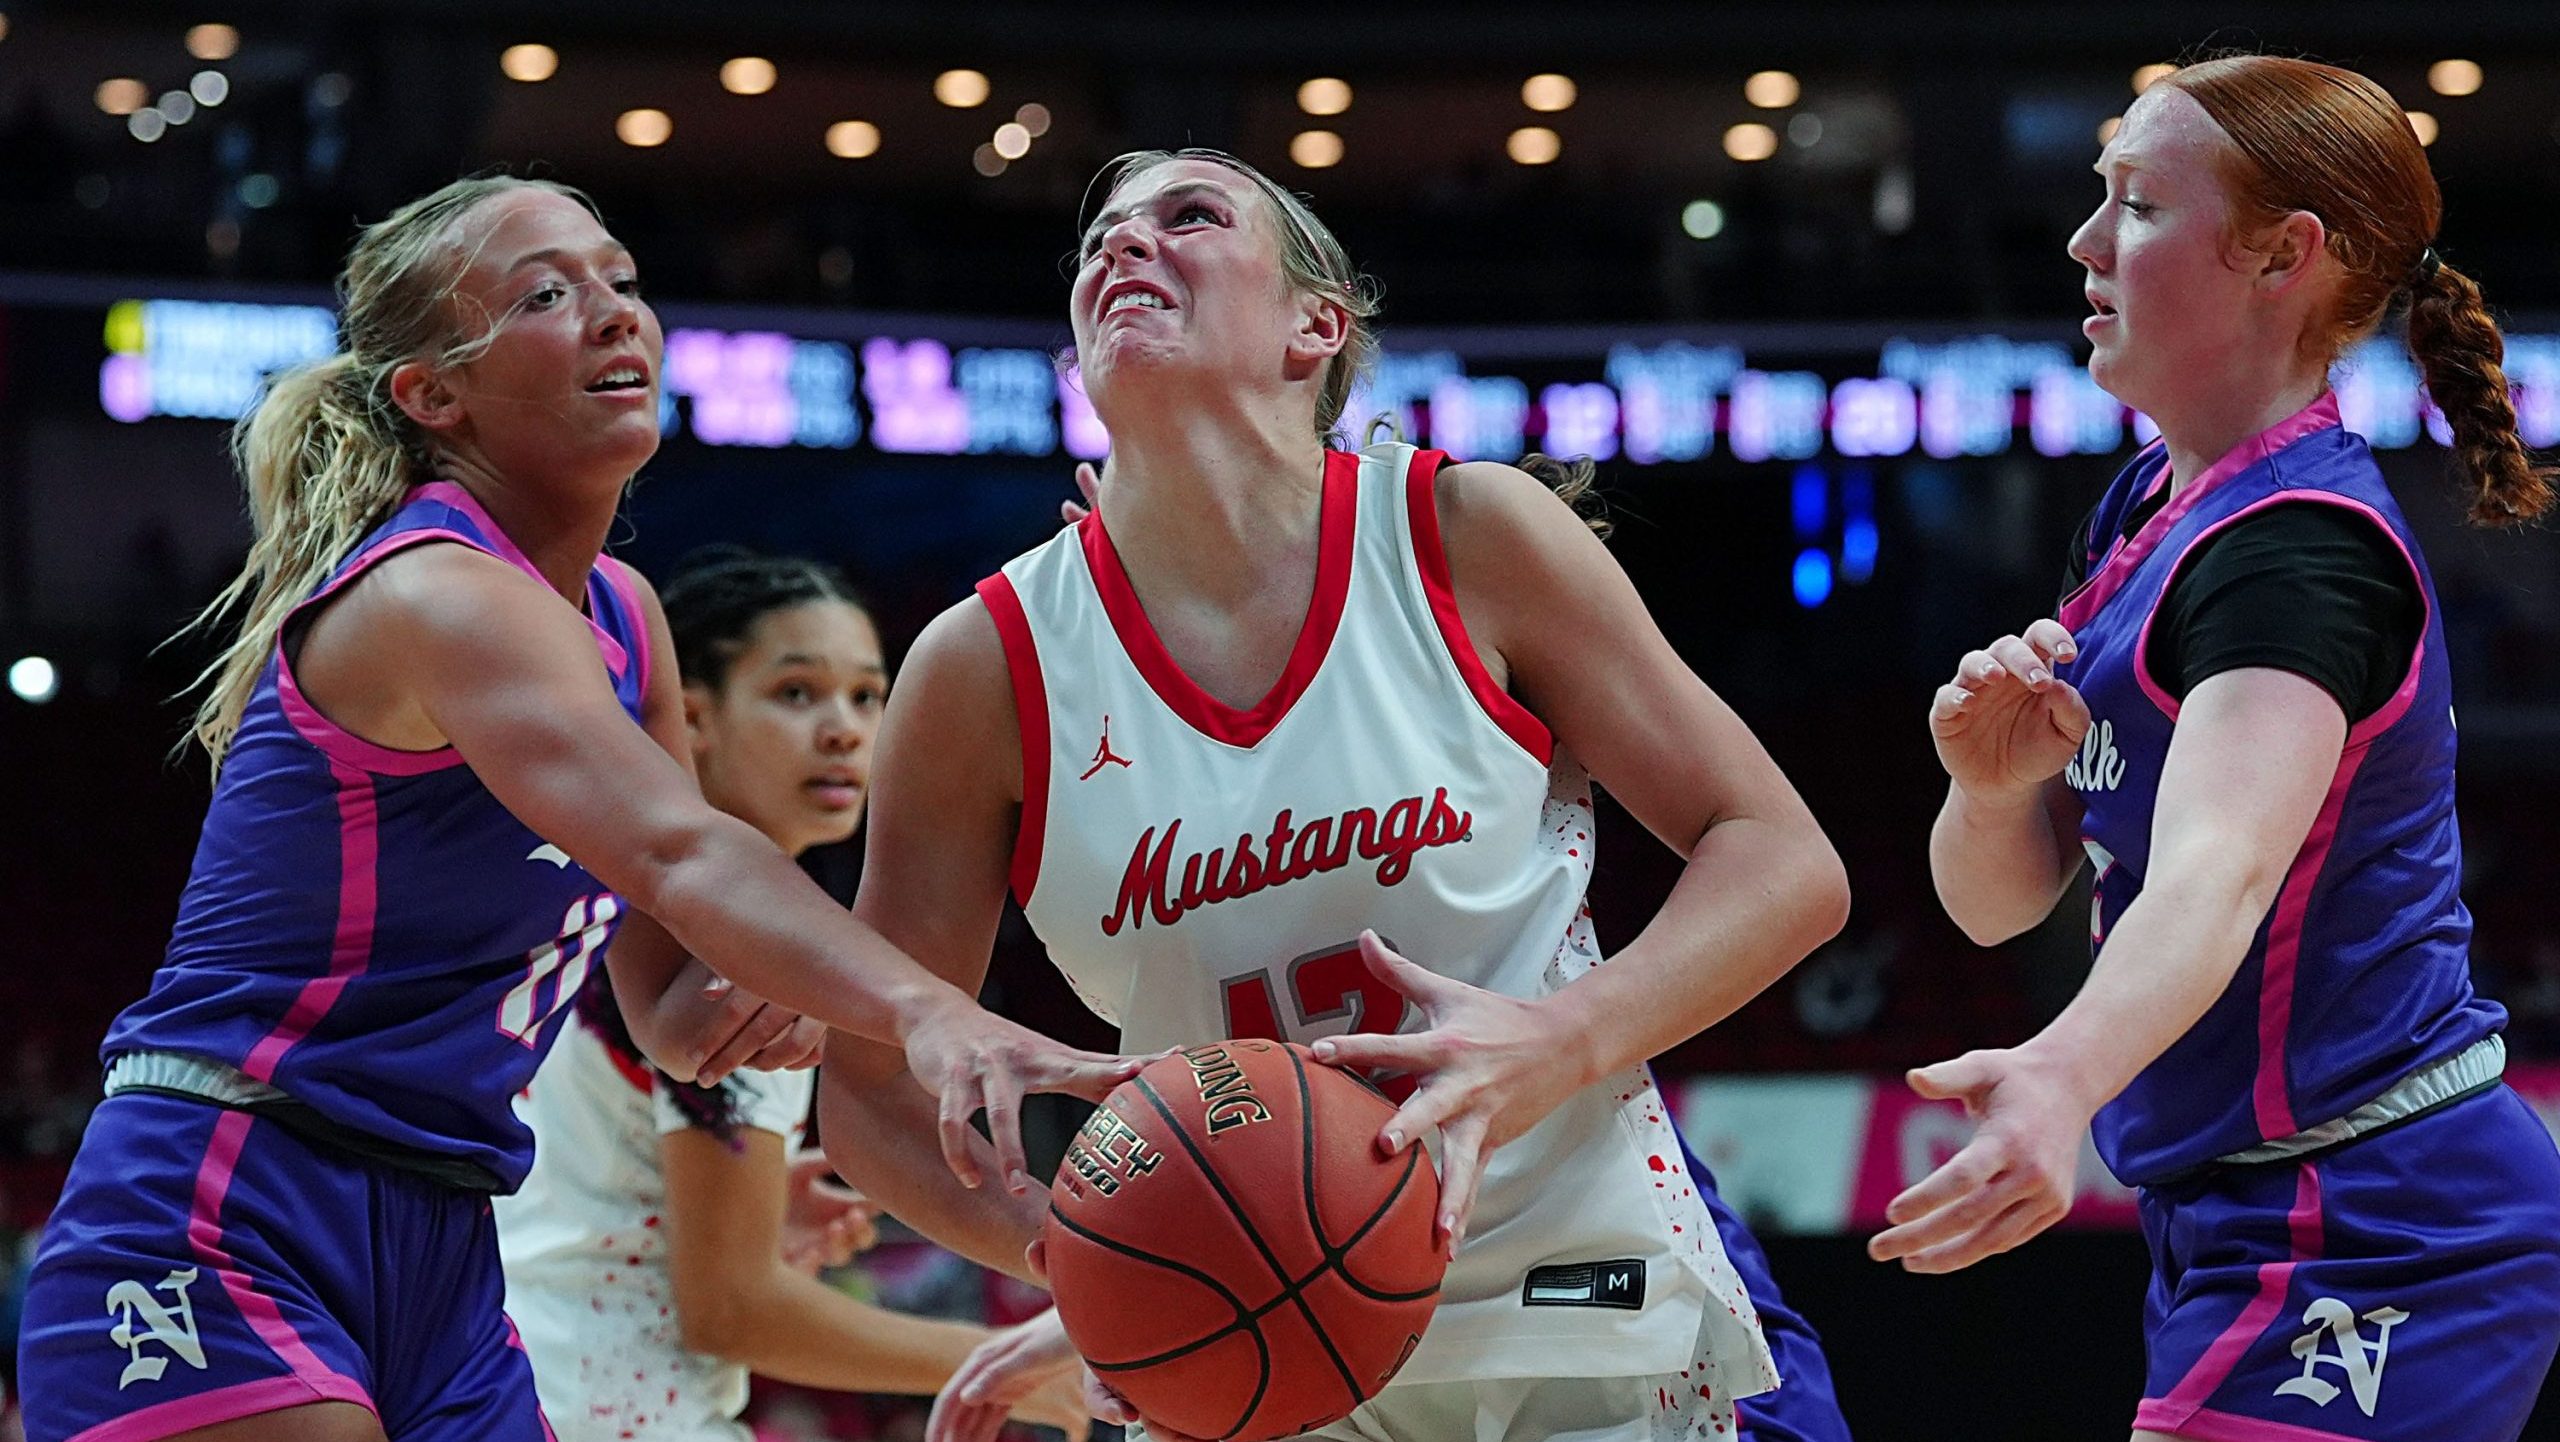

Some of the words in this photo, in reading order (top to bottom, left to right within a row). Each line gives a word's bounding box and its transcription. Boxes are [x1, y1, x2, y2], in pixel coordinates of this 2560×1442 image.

[1101, 786, 1472, 936] Mustangs
[495, 892, 618, 1050] 11
[1182, 1047, 1273, 1136] DING
[1608, 1272, 1629, 1292] M
